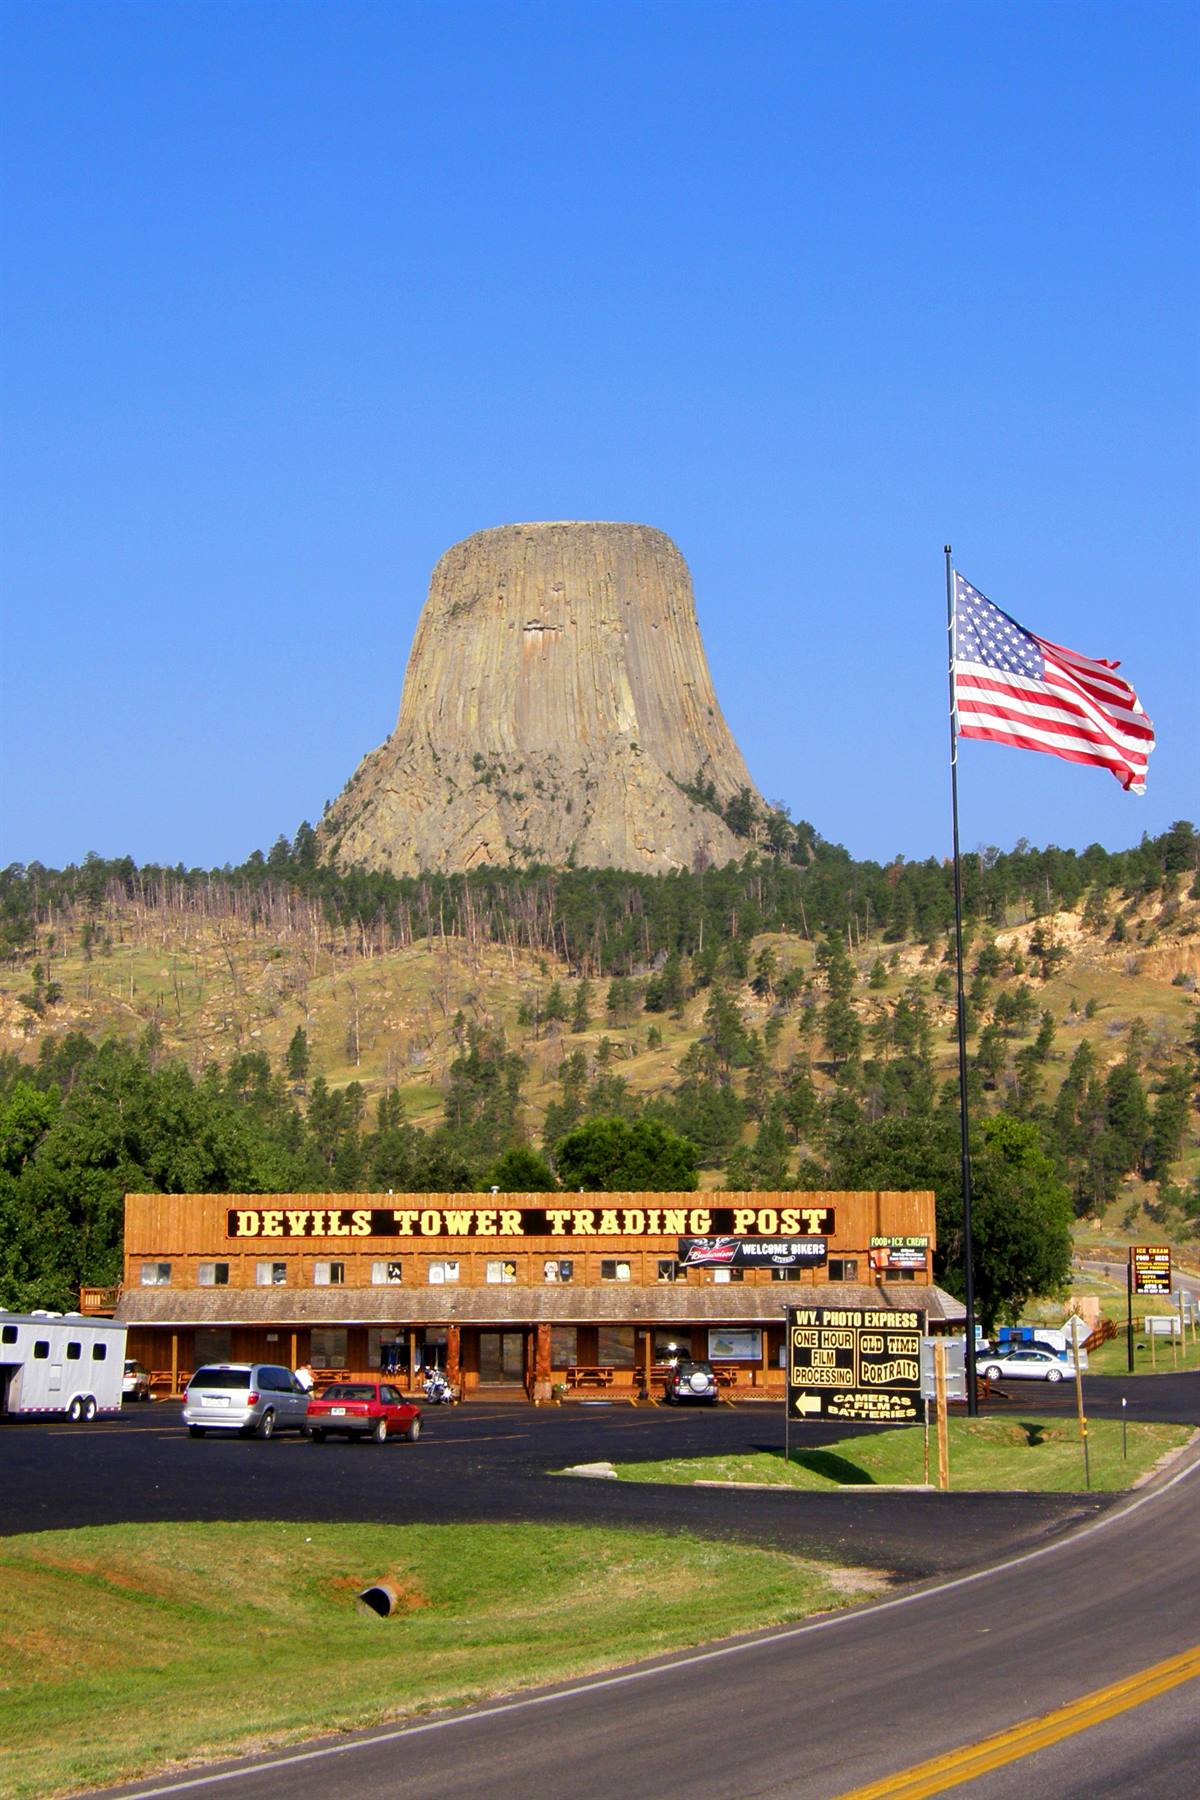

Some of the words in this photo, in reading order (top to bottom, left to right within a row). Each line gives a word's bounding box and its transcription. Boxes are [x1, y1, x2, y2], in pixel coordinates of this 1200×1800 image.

[236, 1210, 372, 1237] DEVILS
[393, 1209, 524, 1236] TOWER
[546, 1209, 712, 1235] TRADING
[733, 1209, 827, 1235] POST
[742, 1243, 788, 1255] WELCOME
[791, 1243, 826, 1255] BIKERS
[906, 1237, 928, 1247] CREAM
[690, 1249, 734, 1260] Budweiser
[796, 1310, 820, 1326] WY.
[823, 1311, 862, 1327] PHOTO
[864, 1312, 918, 1328] EXPRESS
[795, 1331, 818, 1347] ONE
[822, 1332, 852, 1348] HOUR
[861, 1336, 883, 1353] OLD
[888, 1337, 918, 1354] TIME
[813, 1350, 835, 1366] FILM
[795, 1368, 852, 1384] PROCESSING
[862, 1360, 918, 1383] PORTRAITS
[833, 1393, 912, 1406] CAMERAS
[853, 1402, 891, 1410] FILM
[827, 1406, 917, 1419] BATTERIES
